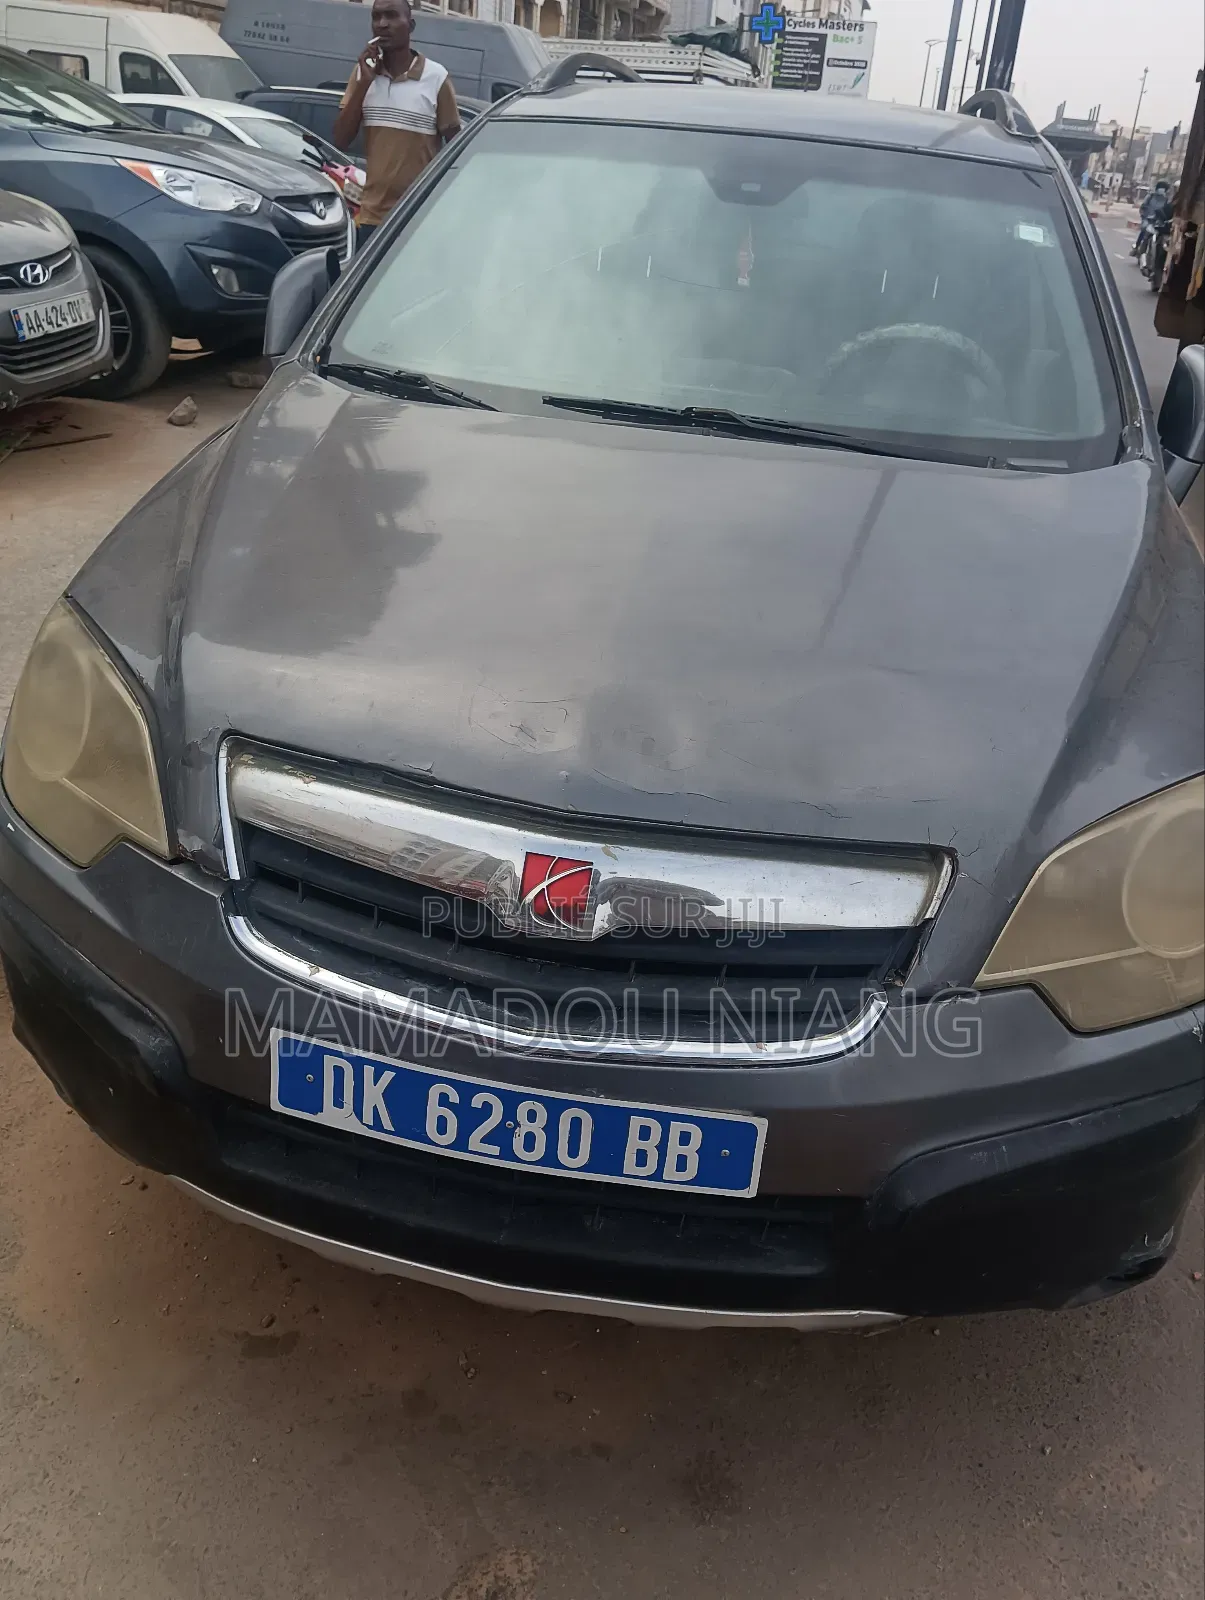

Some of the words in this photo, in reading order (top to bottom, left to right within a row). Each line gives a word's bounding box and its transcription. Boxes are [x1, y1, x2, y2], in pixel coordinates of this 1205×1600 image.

[786, 18, 816, 30] Cycles
[818, 18, 865, 32] Masters
[322, 1054, 397, 1132] DK
[425, 1083, 594, 1169] 6280
[622, 1115, 703, 1182] BB
